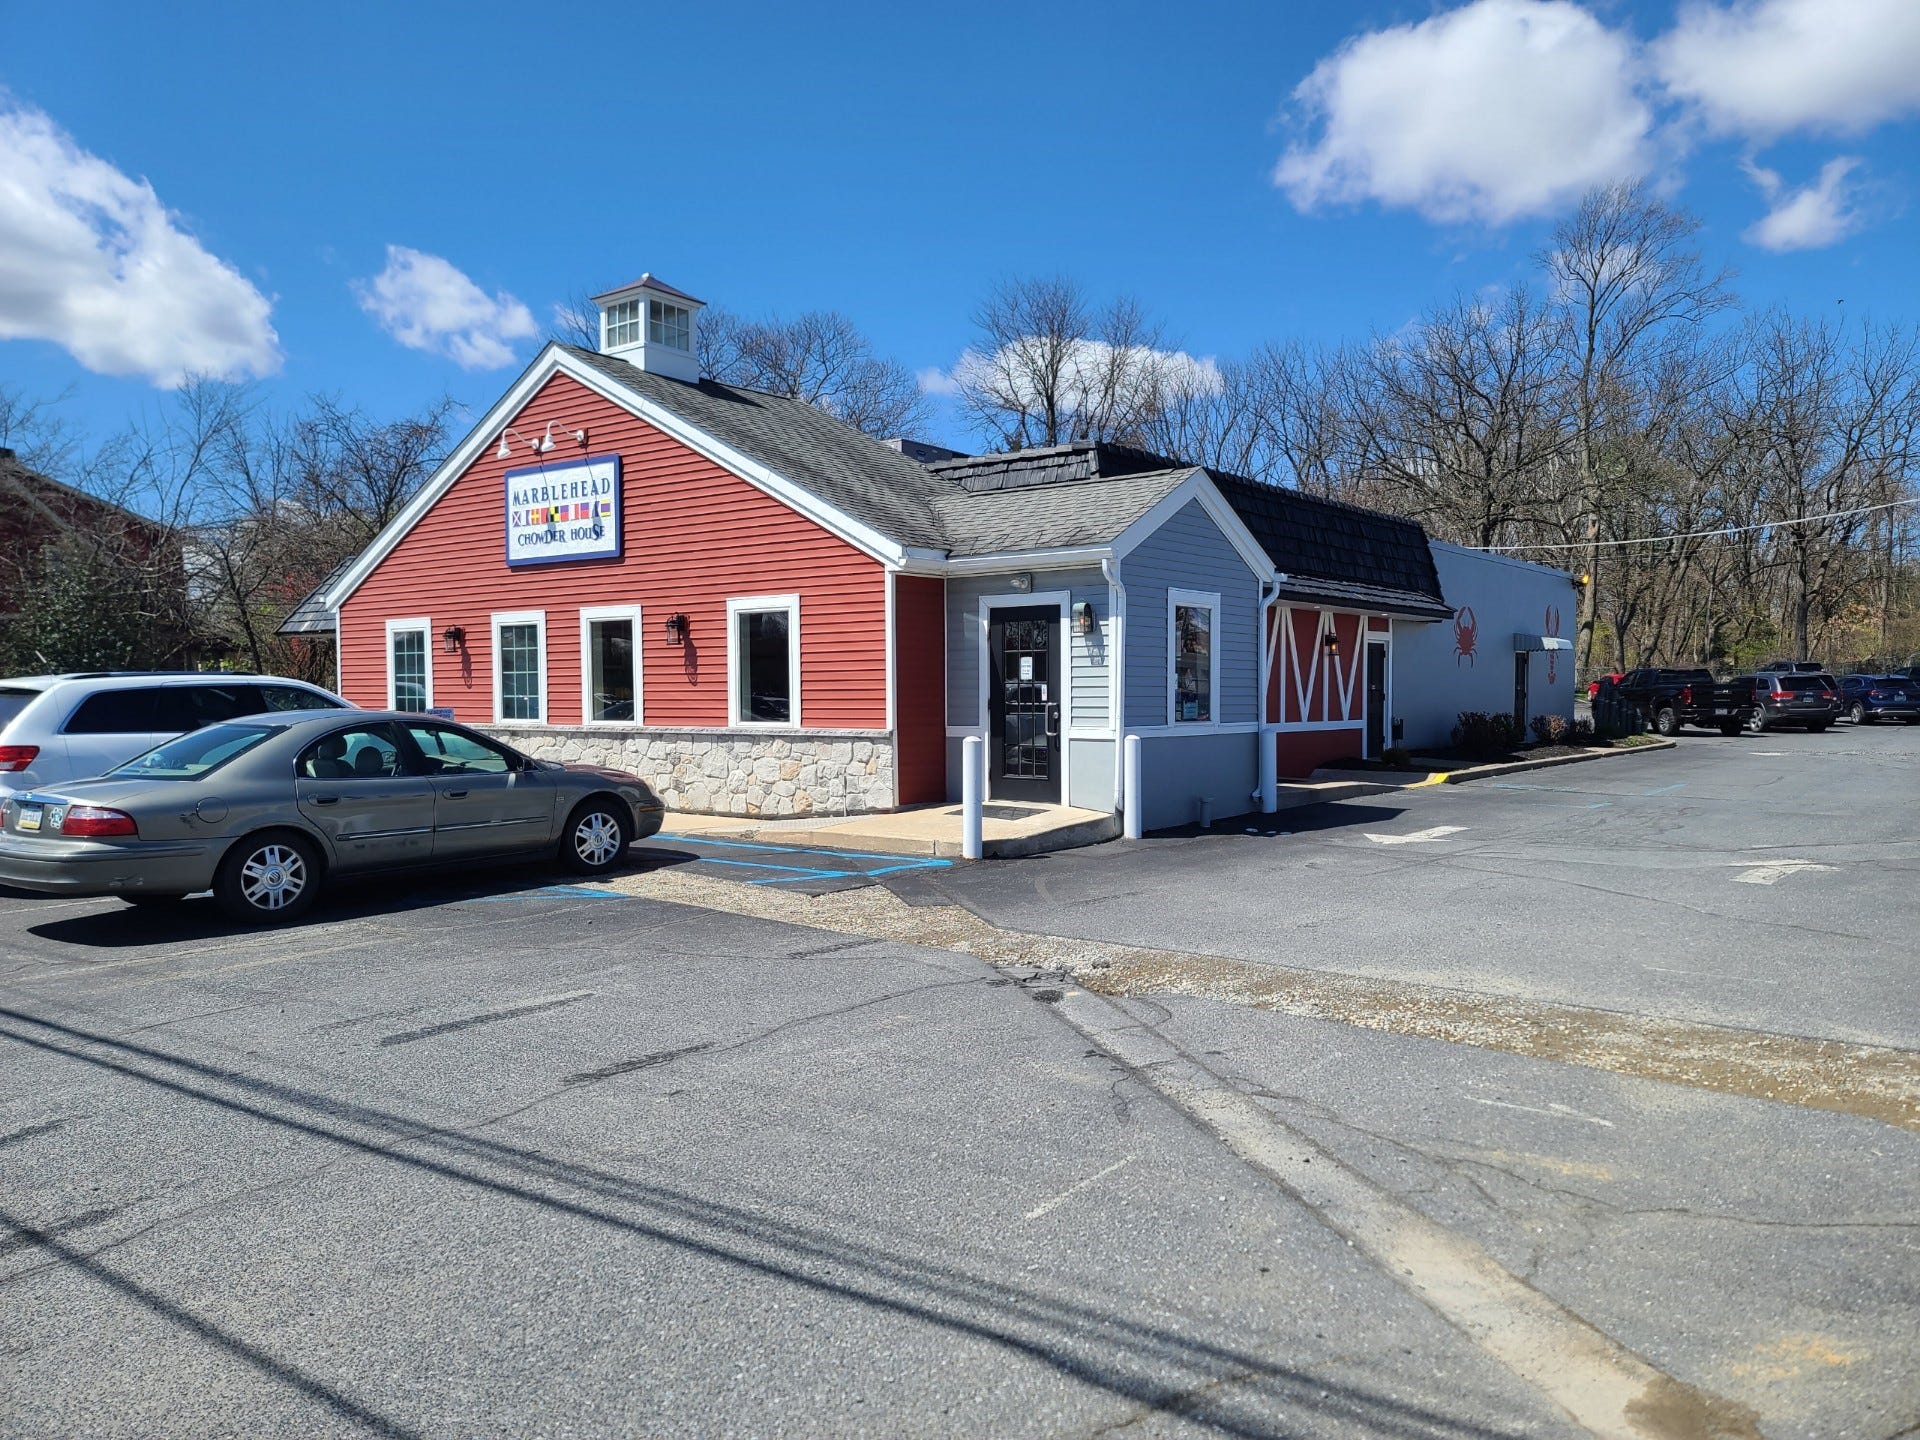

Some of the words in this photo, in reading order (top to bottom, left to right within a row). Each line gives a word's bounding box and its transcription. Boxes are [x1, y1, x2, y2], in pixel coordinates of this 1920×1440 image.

[512, 478, 610, 506] MARBLEHEAD
[518, 529, 566, 546] CHOWDER
[570, 524, 605, 541] HOUSE
